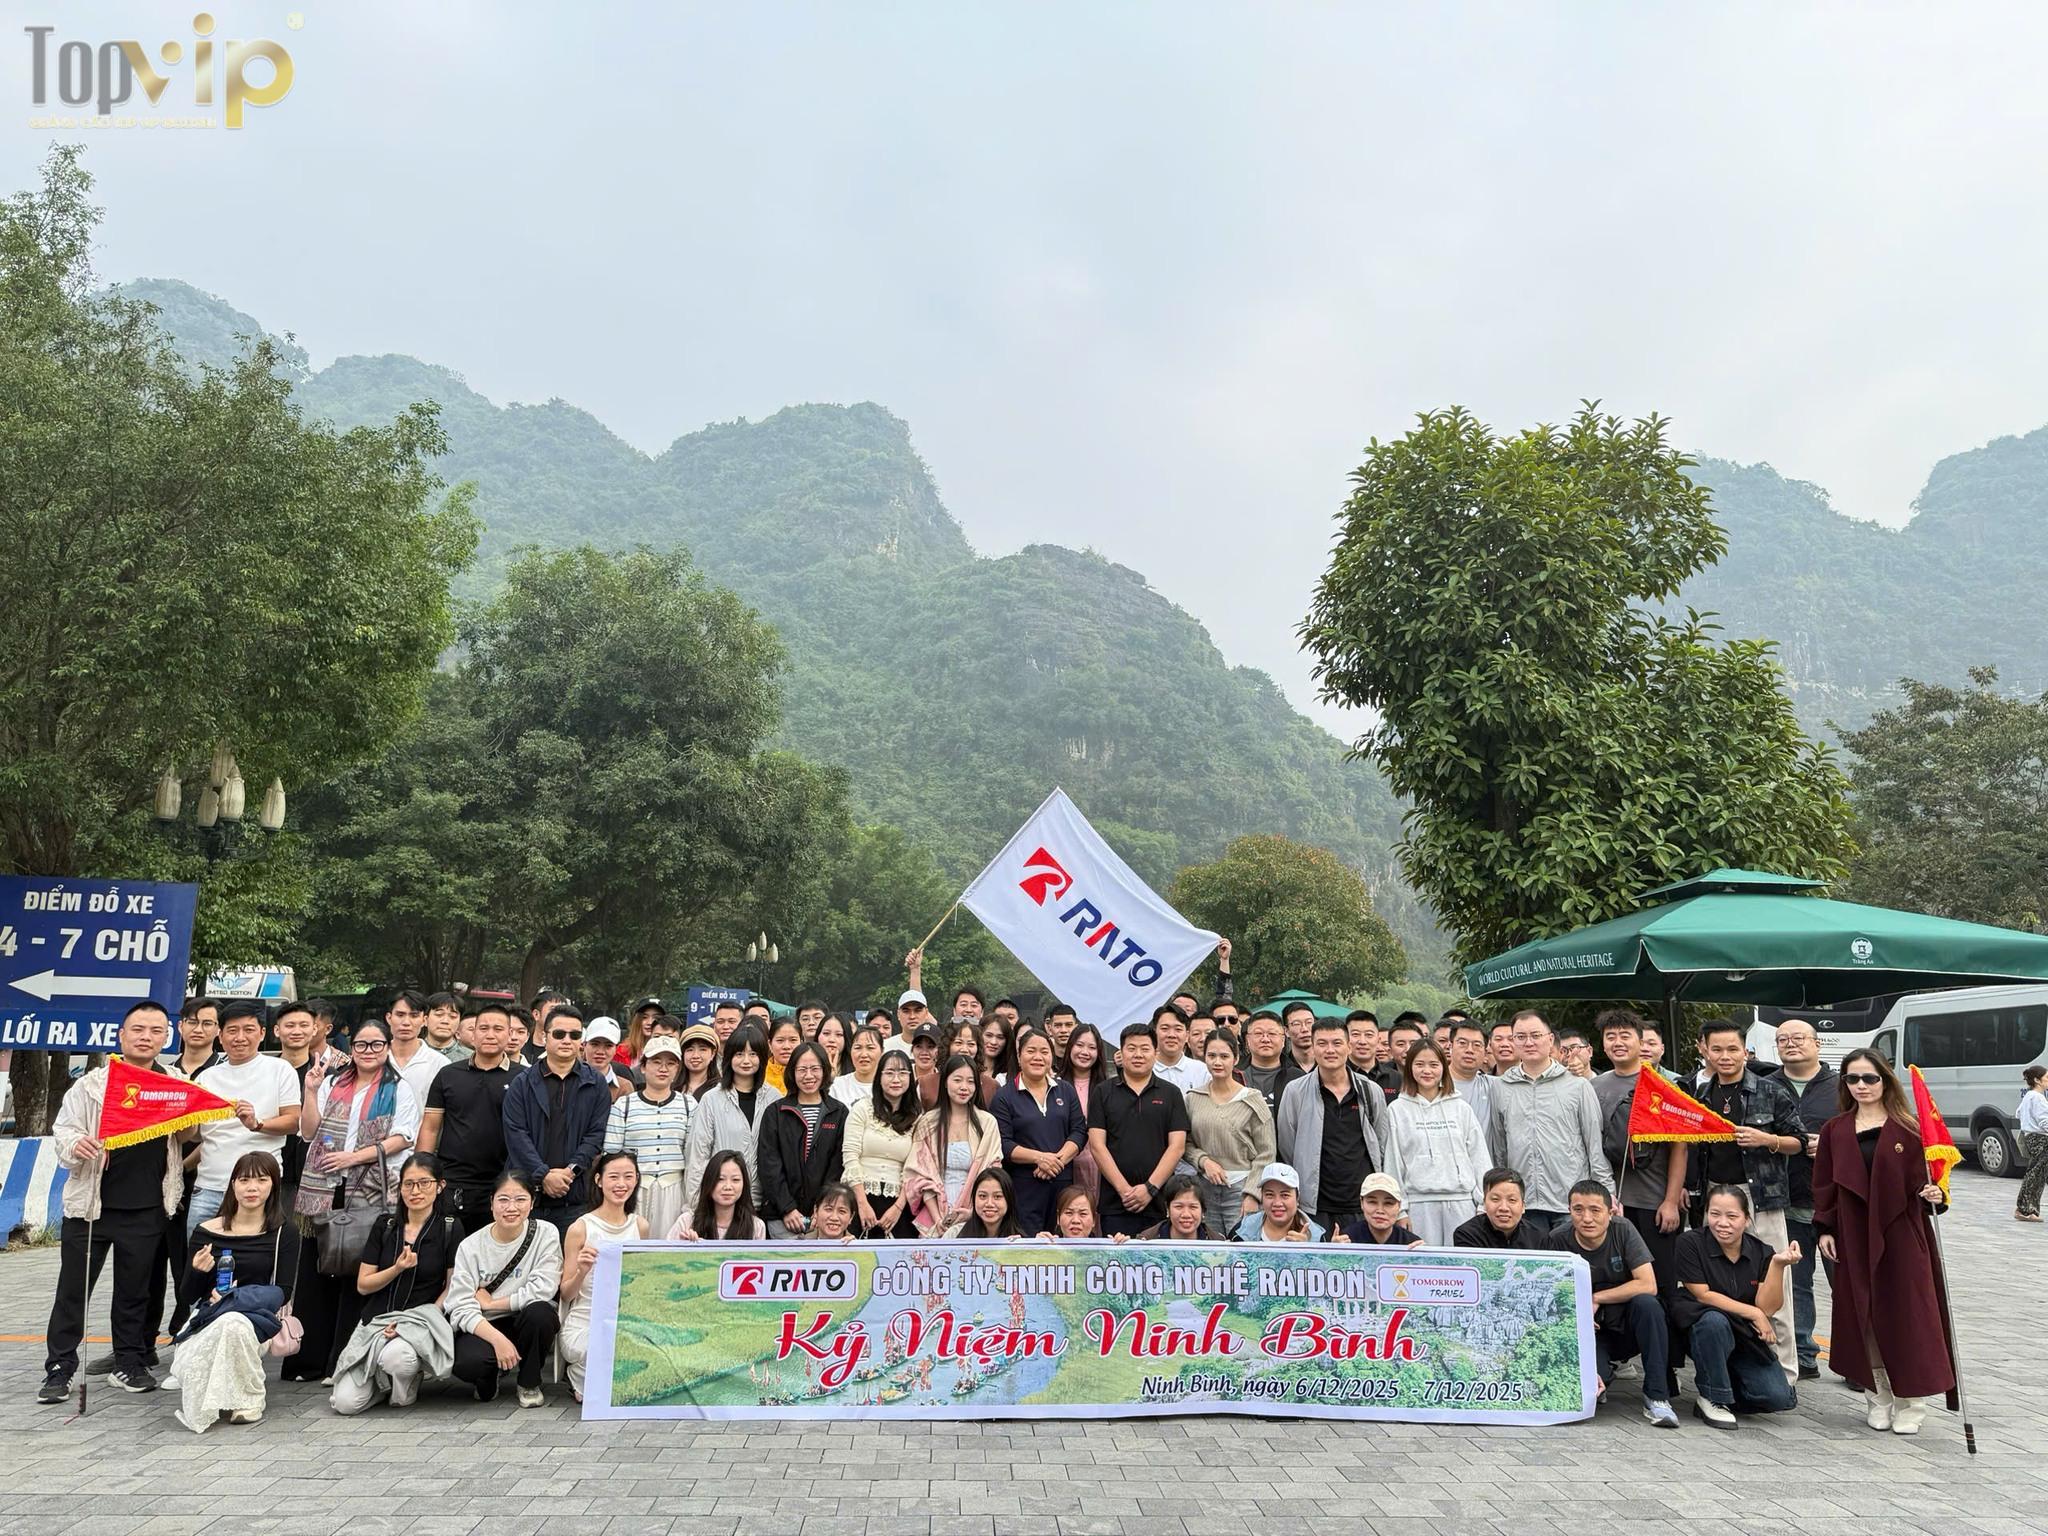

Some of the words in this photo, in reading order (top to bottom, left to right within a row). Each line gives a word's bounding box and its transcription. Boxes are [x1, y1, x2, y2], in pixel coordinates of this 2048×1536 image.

[24, 884, 82, 912] ĐIỂM
[89, 886, 119, 913] ĐỖ
[125, 895, 155, 915] XE
[0, 925, 18, 957] 4
[60, 927, 83, 959] 7
[94, 919, 170, 963] CHỖ
[1059, 897, 1163, 987] RATO
[1478, 971, 1500, 986] WORLD
[1500, 962, 1533, 981] CULTURAL
[1533, 959, 1547, 973] AND
[1546, 956, 1577, 971] NATURAL
[1577, 952, 1615, 968] HERITAGE
[690, 1001, 698, 1013] 9
[729, 992, 737, 1000] XE
[2, 1013, 41, 1045] LỐI
[47, 1021, 78, 1045] RA
[86, 1023, 120, 1047] XE
[140, 1090, 188, 1101] TOMORROW
[1662, 1101, 1705, 1122] TOMORROW
[770, 1268, 845, 1292] RATO
[872, 1260, 951, 1297] CÔNG
[959, 1265, 995, 1296] TY
[1001, 1264, 1076, 1296] TNHH
[1085, 1259, 1165, 1296] CÔNG
[1174, 1260, 1250, 1302] NGHỆ
[1258, 1266, 1366, 1299] RAIDON
[1411, 1277, 1466, 1288] TOMORROW
[1429, 1288, 1466, 1299] TRAVEL
[775, 1309, 870, 1388] Kỷ
[891, 1308, 1069, 1366] Niệm
[1083, 1302, 1246, 1359] Ninh
[1259, 1308, 1427, 1362] Bình
[1141, 1375, 1185, 1395] Ninh
[1190, 1374, 1237, 1395] Bình,
[1243, 1378, 1290, 1399] ngày
[1295, 1376, 1400, 1398] 6/12/2025
[1423, 1380, 1523, 1401] 7/12/2025
